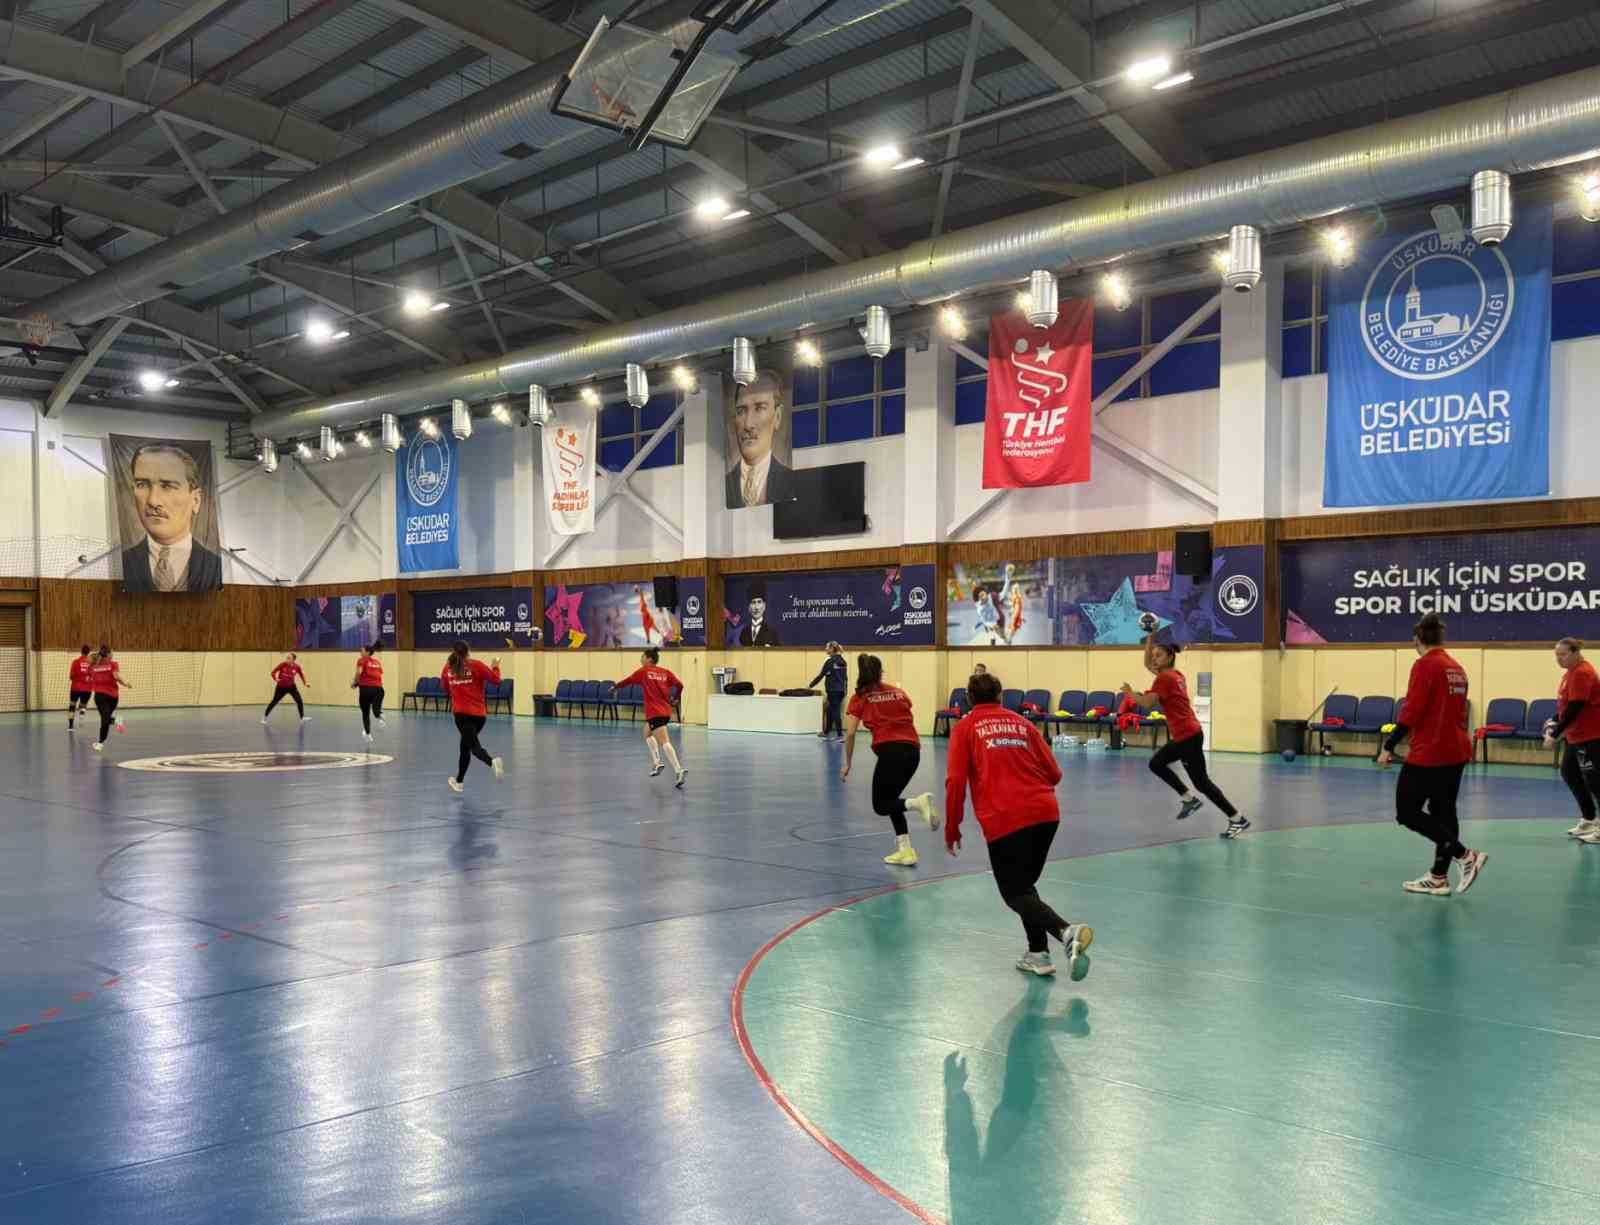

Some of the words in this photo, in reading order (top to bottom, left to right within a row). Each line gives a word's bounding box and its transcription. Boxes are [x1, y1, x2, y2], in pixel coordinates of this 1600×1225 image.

[1368, 312, 1421, 371] BELEDİYE
[1003, 406, 1069, 437] THF
[1360, 389, 1510, 431] ÜSKÜDAR
[1360, 421, 1510, 456] BELEDİYESİ
[1353, 564, 1441, 588] SAĞLIK
[1448, 561, 1500, 591] İÇİN
[1508, 561, 1586, 584] SPOR
[481, 606, 506, 617] SPOR
[1334, 596, 1402, 615] SPOR
[430, 622, 452, 633] SPOR
